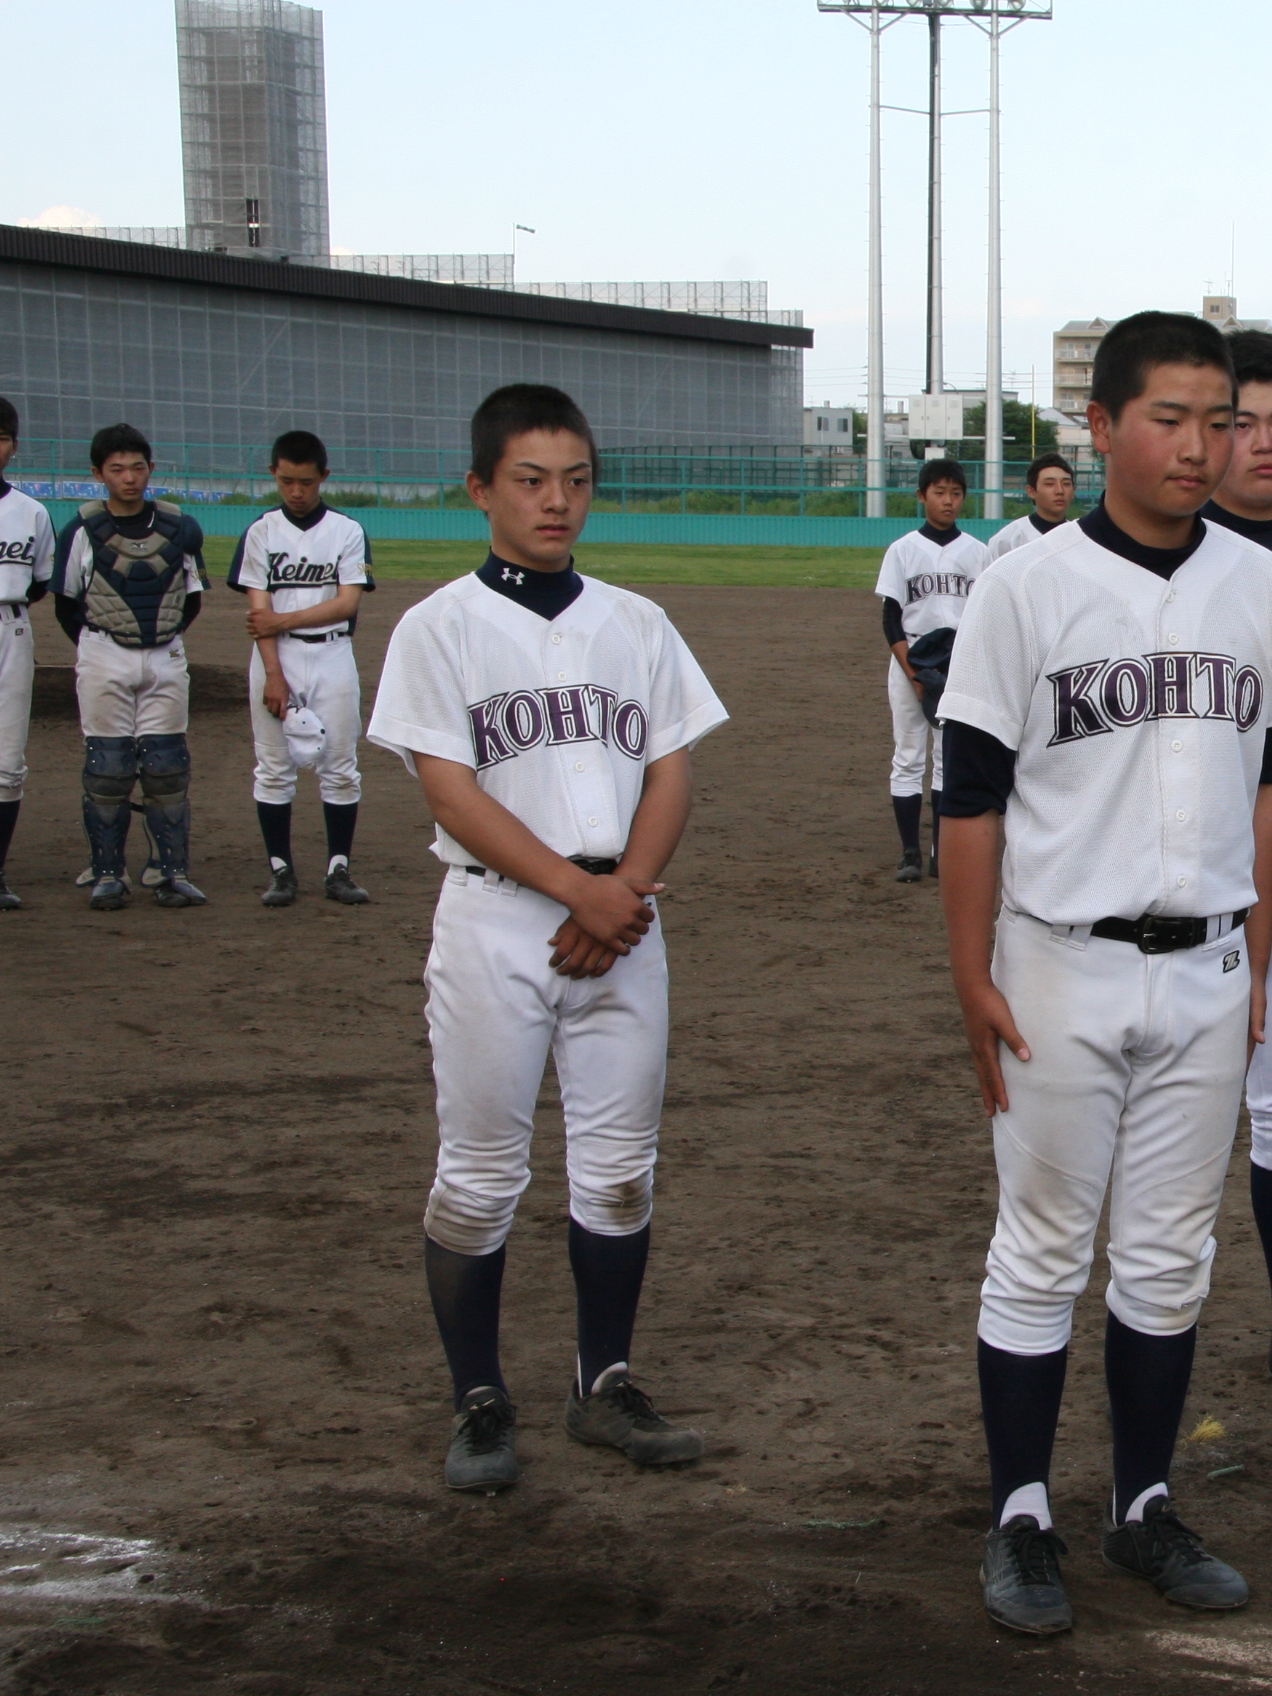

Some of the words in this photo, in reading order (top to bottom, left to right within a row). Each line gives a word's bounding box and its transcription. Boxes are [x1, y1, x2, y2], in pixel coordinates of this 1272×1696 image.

[267, 552, 341, 584] Keimei
[467, 683, 649, 771] KOHTO
[1045, 651, 1263, 747] KOHTO
